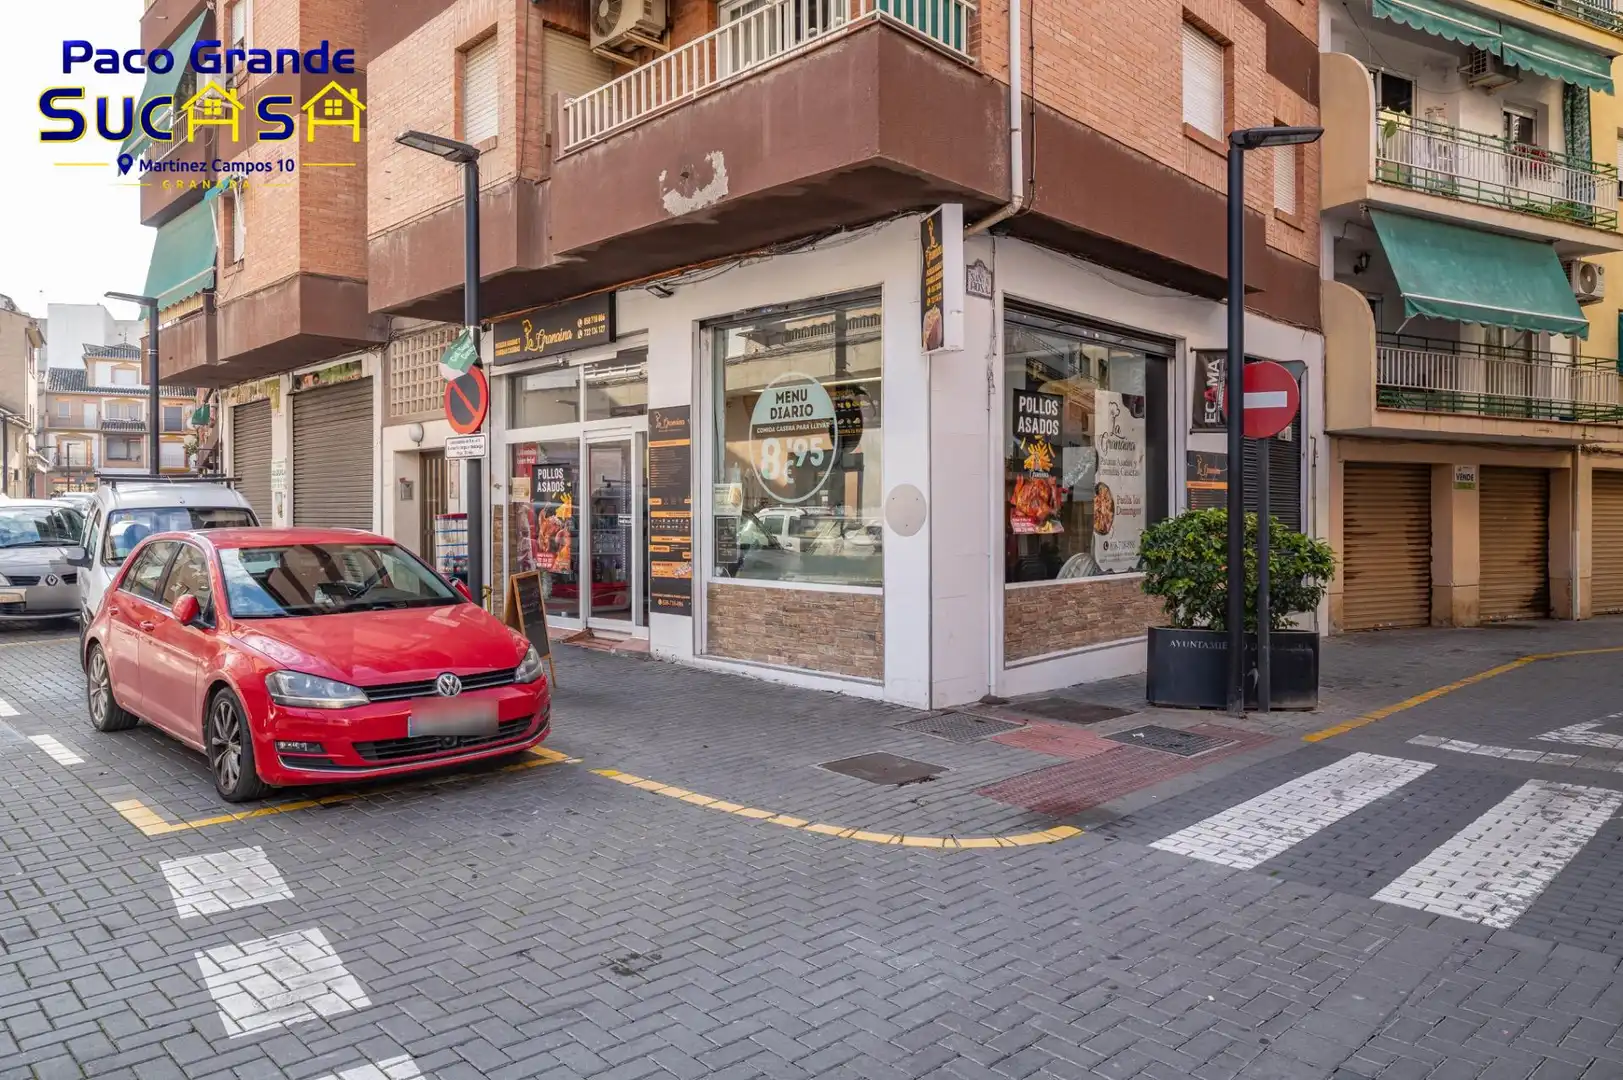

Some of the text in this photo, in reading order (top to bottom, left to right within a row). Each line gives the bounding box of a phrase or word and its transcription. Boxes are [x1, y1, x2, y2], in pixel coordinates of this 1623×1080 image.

[775, 389, 808, 405] MENU
[1204, 359, 1220, 423] ECAMA
[770, 404, 814, 420] DIARIO
[1018, 395, 1058, 416] POLLOS
[757, 426, 775, 434] COMIDA
[796, 423, 810, 431] PARA
[1017, 416, 1060, 436] ASADOS
[537, 467, 564, 480] POLLOS
[536, 480, 565, 492] ASADOS
[1169, 639, 1240, 650] AYUNTAMIE
